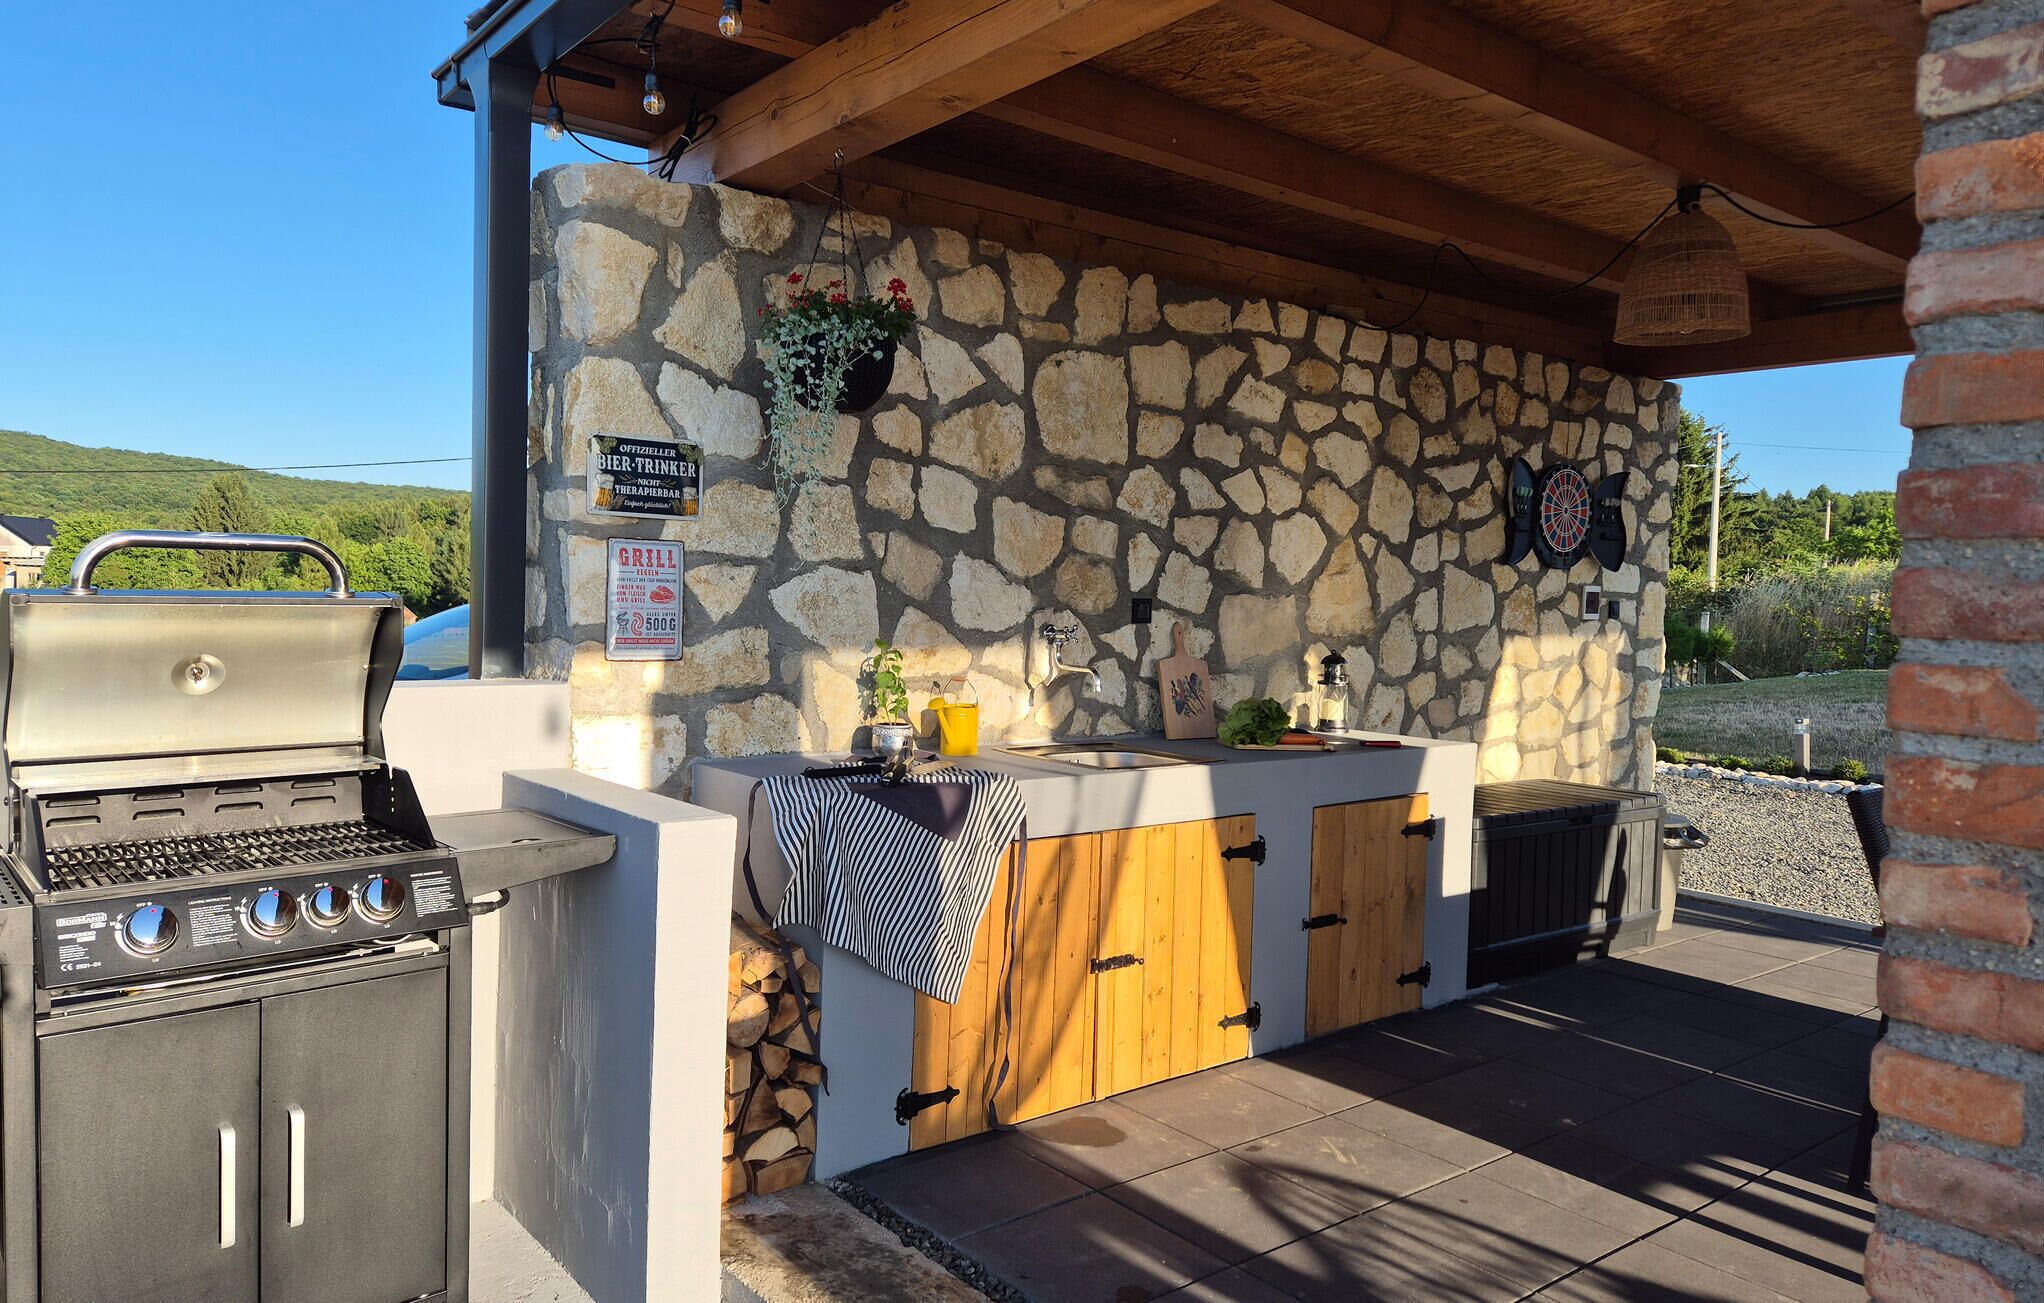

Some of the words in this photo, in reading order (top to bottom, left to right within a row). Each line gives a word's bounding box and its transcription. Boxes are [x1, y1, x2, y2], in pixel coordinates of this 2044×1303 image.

[619, 444, 676, 457] OFFIZIELLER
[637, 478, 661, 486] NICHT
[614, 484, 680, 498] THERAPIERBAR
[618, 547, 676, 569] GRILL
[56, 913, 107, 926] BORMANN
